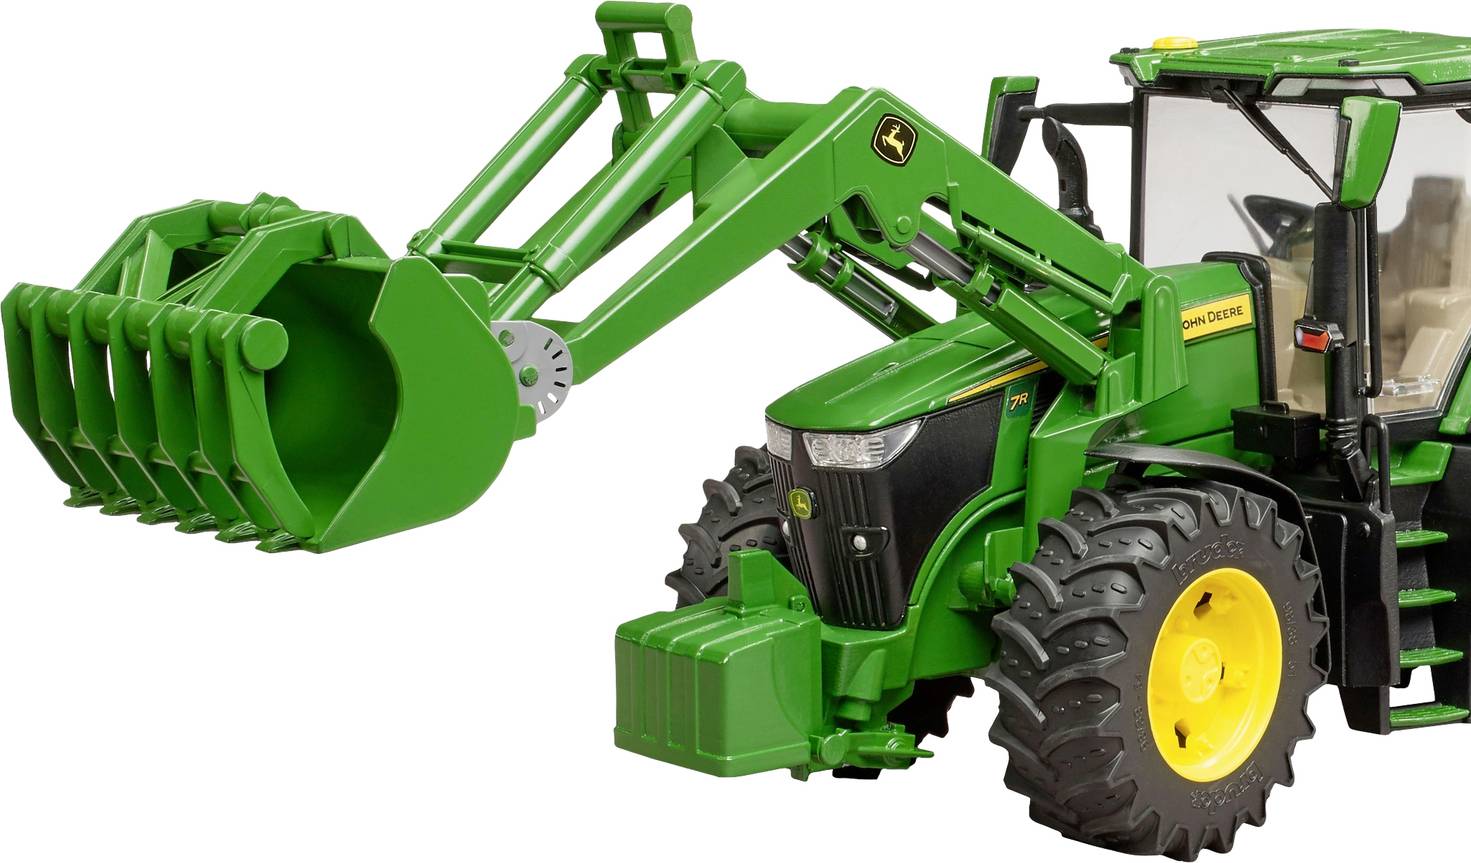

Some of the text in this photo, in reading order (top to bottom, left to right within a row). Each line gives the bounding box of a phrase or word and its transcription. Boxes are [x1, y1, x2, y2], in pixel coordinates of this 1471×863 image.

[1182, 306, 1244, 330] OHN DEERE
[1010, 392, 1029, 410] 7R
[1170, 533, 1249, 587] bruder
